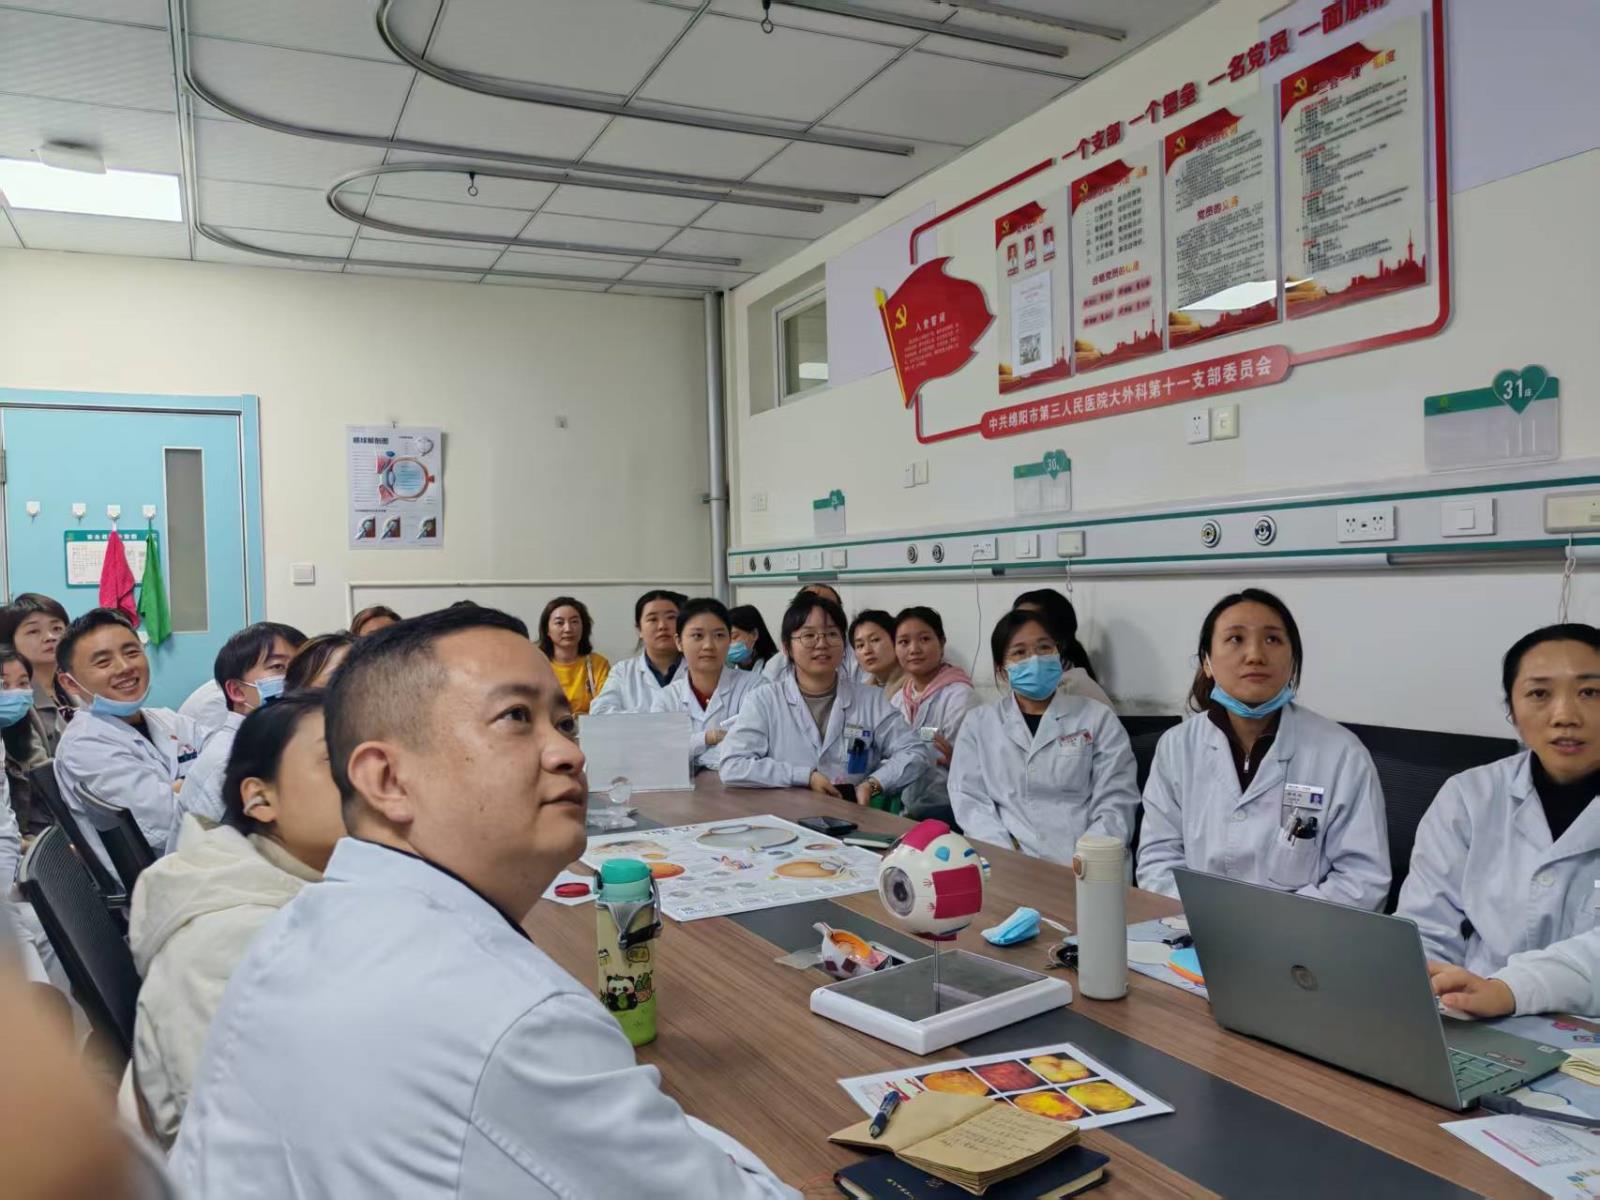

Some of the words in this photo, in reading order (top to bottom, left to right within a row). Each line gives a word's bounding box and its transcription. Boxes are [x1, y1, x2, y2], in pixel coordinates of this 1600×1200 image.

[1062, 121, 1121, 160] 一个支部
[1129, 82, 1196, 123] 一个堡垒
[1208, 28, 1291, 85] 一名党员
[988, 355, 1273, 432] 中共绵阳市第三人民医院大外科第十一支部委员会
